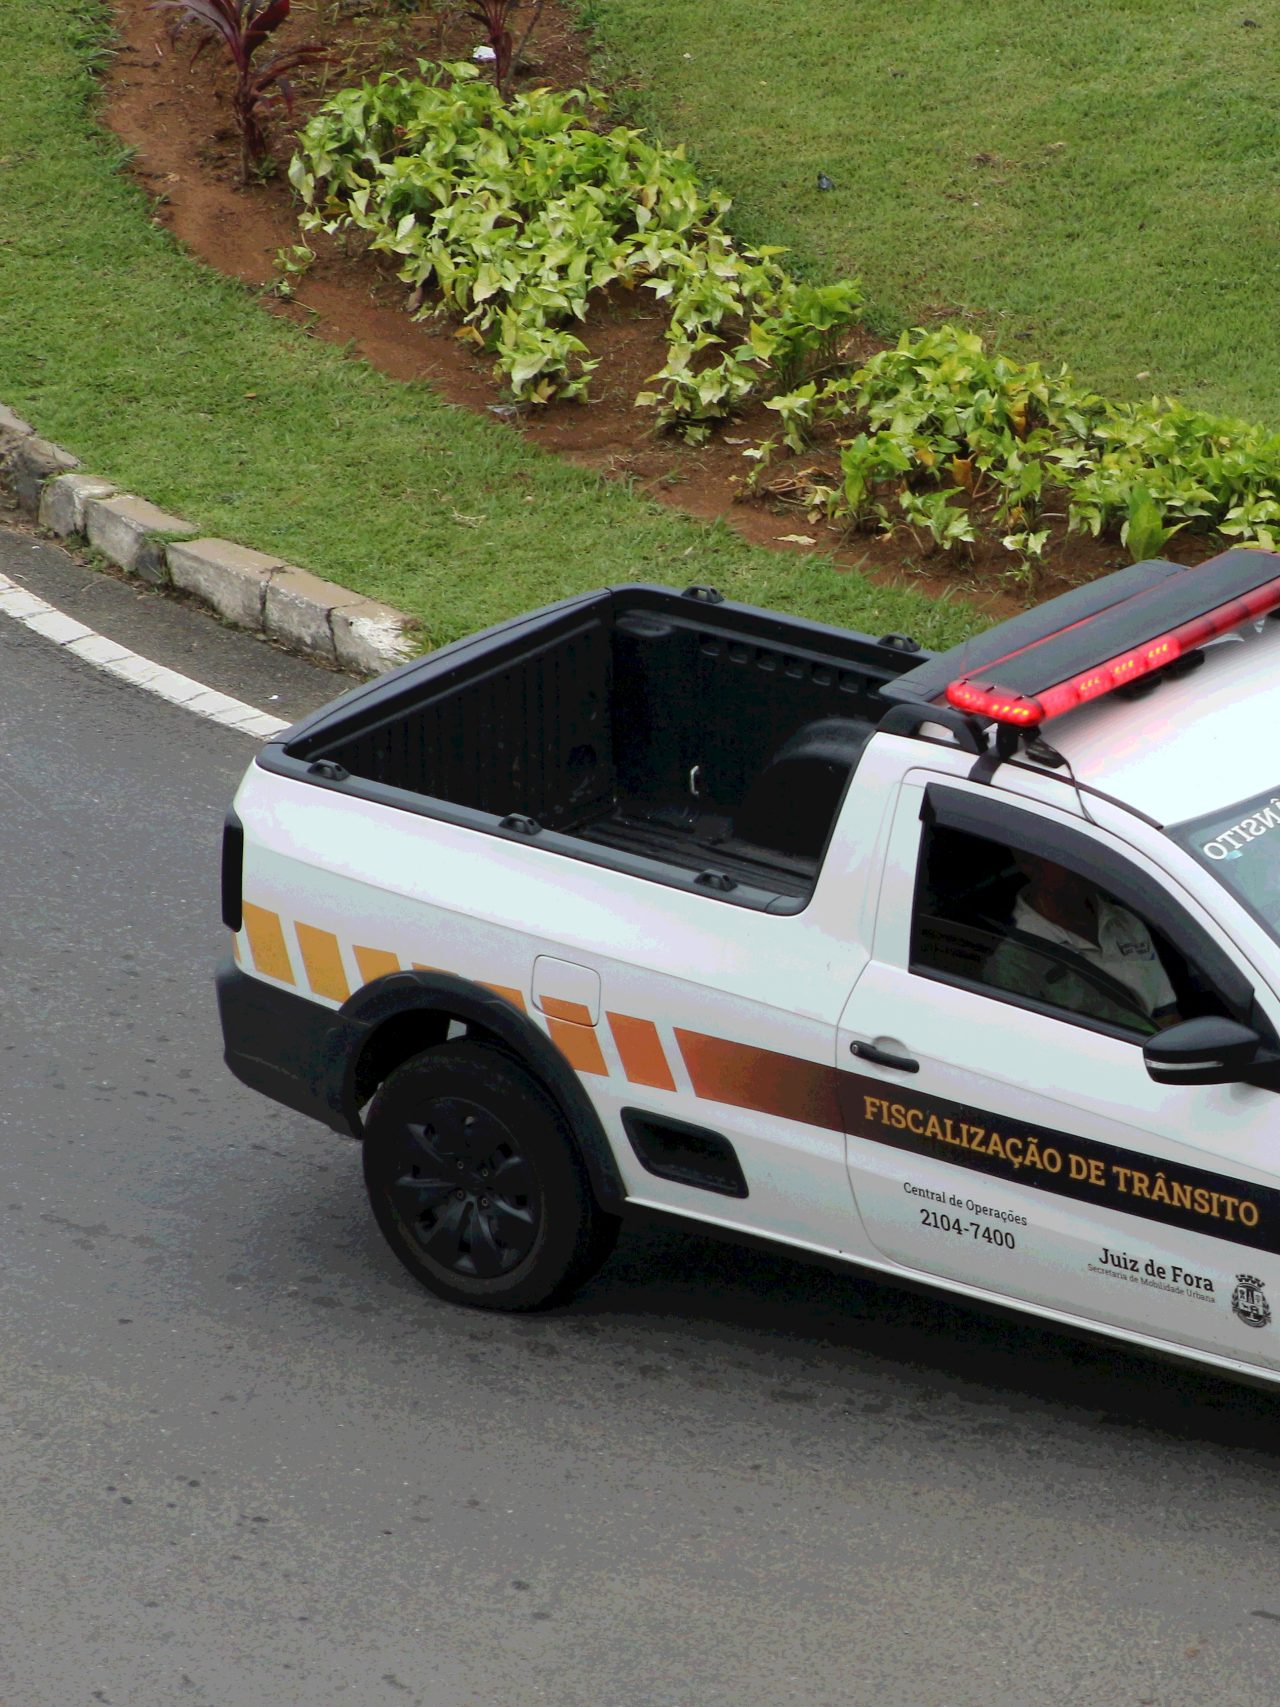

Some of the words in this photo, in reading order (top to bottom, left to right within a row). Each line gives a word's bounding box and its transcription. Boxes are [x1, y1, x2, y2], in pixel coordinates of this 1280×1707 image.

[863, 1095, 1062, 1174] FISCALIZAÇÃO
[1068, 1154, 1106, 1187] DE
[1112, 1165, 1259, 1227] TRÂNSITO
[903, 1182, 946, 1204] Central
[949, 1195, 963, 1208] de
[966, 1199, 1027, 1226] Operações
[920, 1208, 1015, 1249] 2104-7400
[1087, 1263, 1128, 1281] Secretaria
[1129, 1275, 1139, 1283] de
[1140, 1278, 1185, 1296] Mobilidade
[1186, 1288, 1216, 1303] Urbana
[1098, 1247, 1139, 1273] Juiz
[1144, 1259, 1166, 1280] de
[1171, 1265, 1214, 1292] Fora
